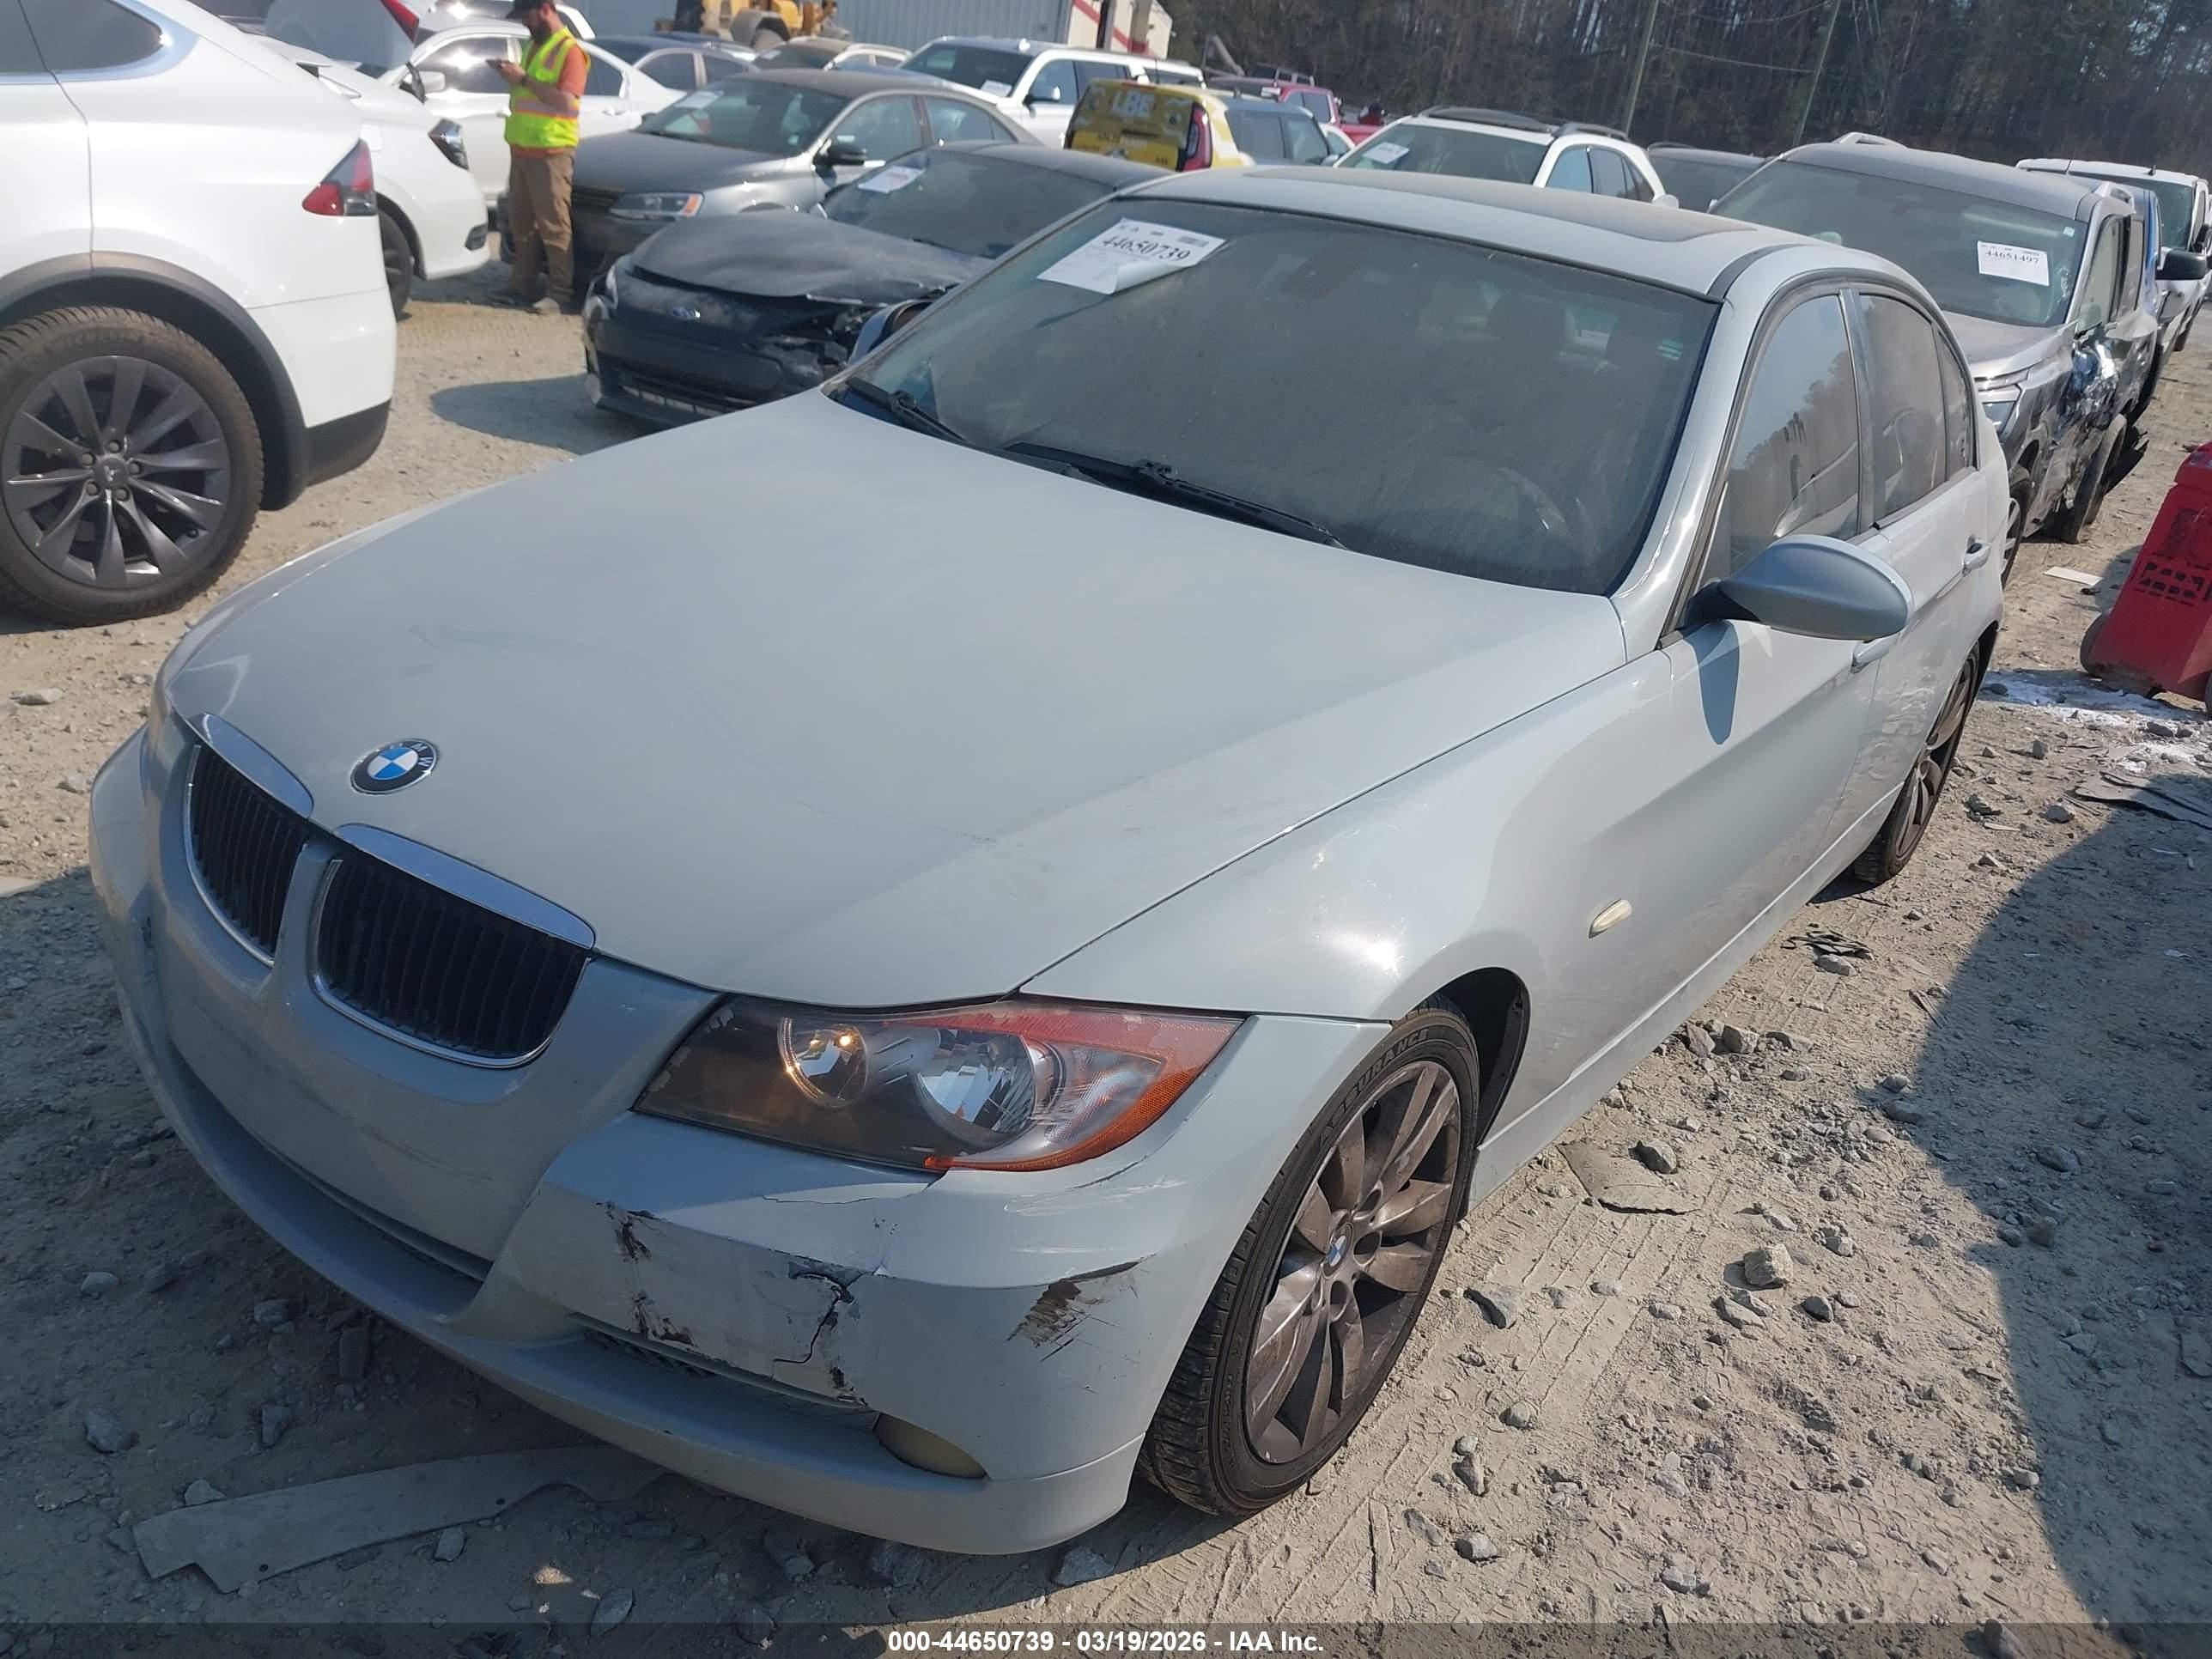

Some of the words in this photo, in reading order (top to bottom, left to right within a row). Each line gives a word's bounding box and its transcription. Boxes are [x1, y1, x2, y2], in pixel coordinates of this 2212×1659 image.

[1103, 234, 1191, 262] 44650739
[1984, 249, 2040, 265] 44651497
[1319, 1028, 1430, 1148] ASSURANCE
